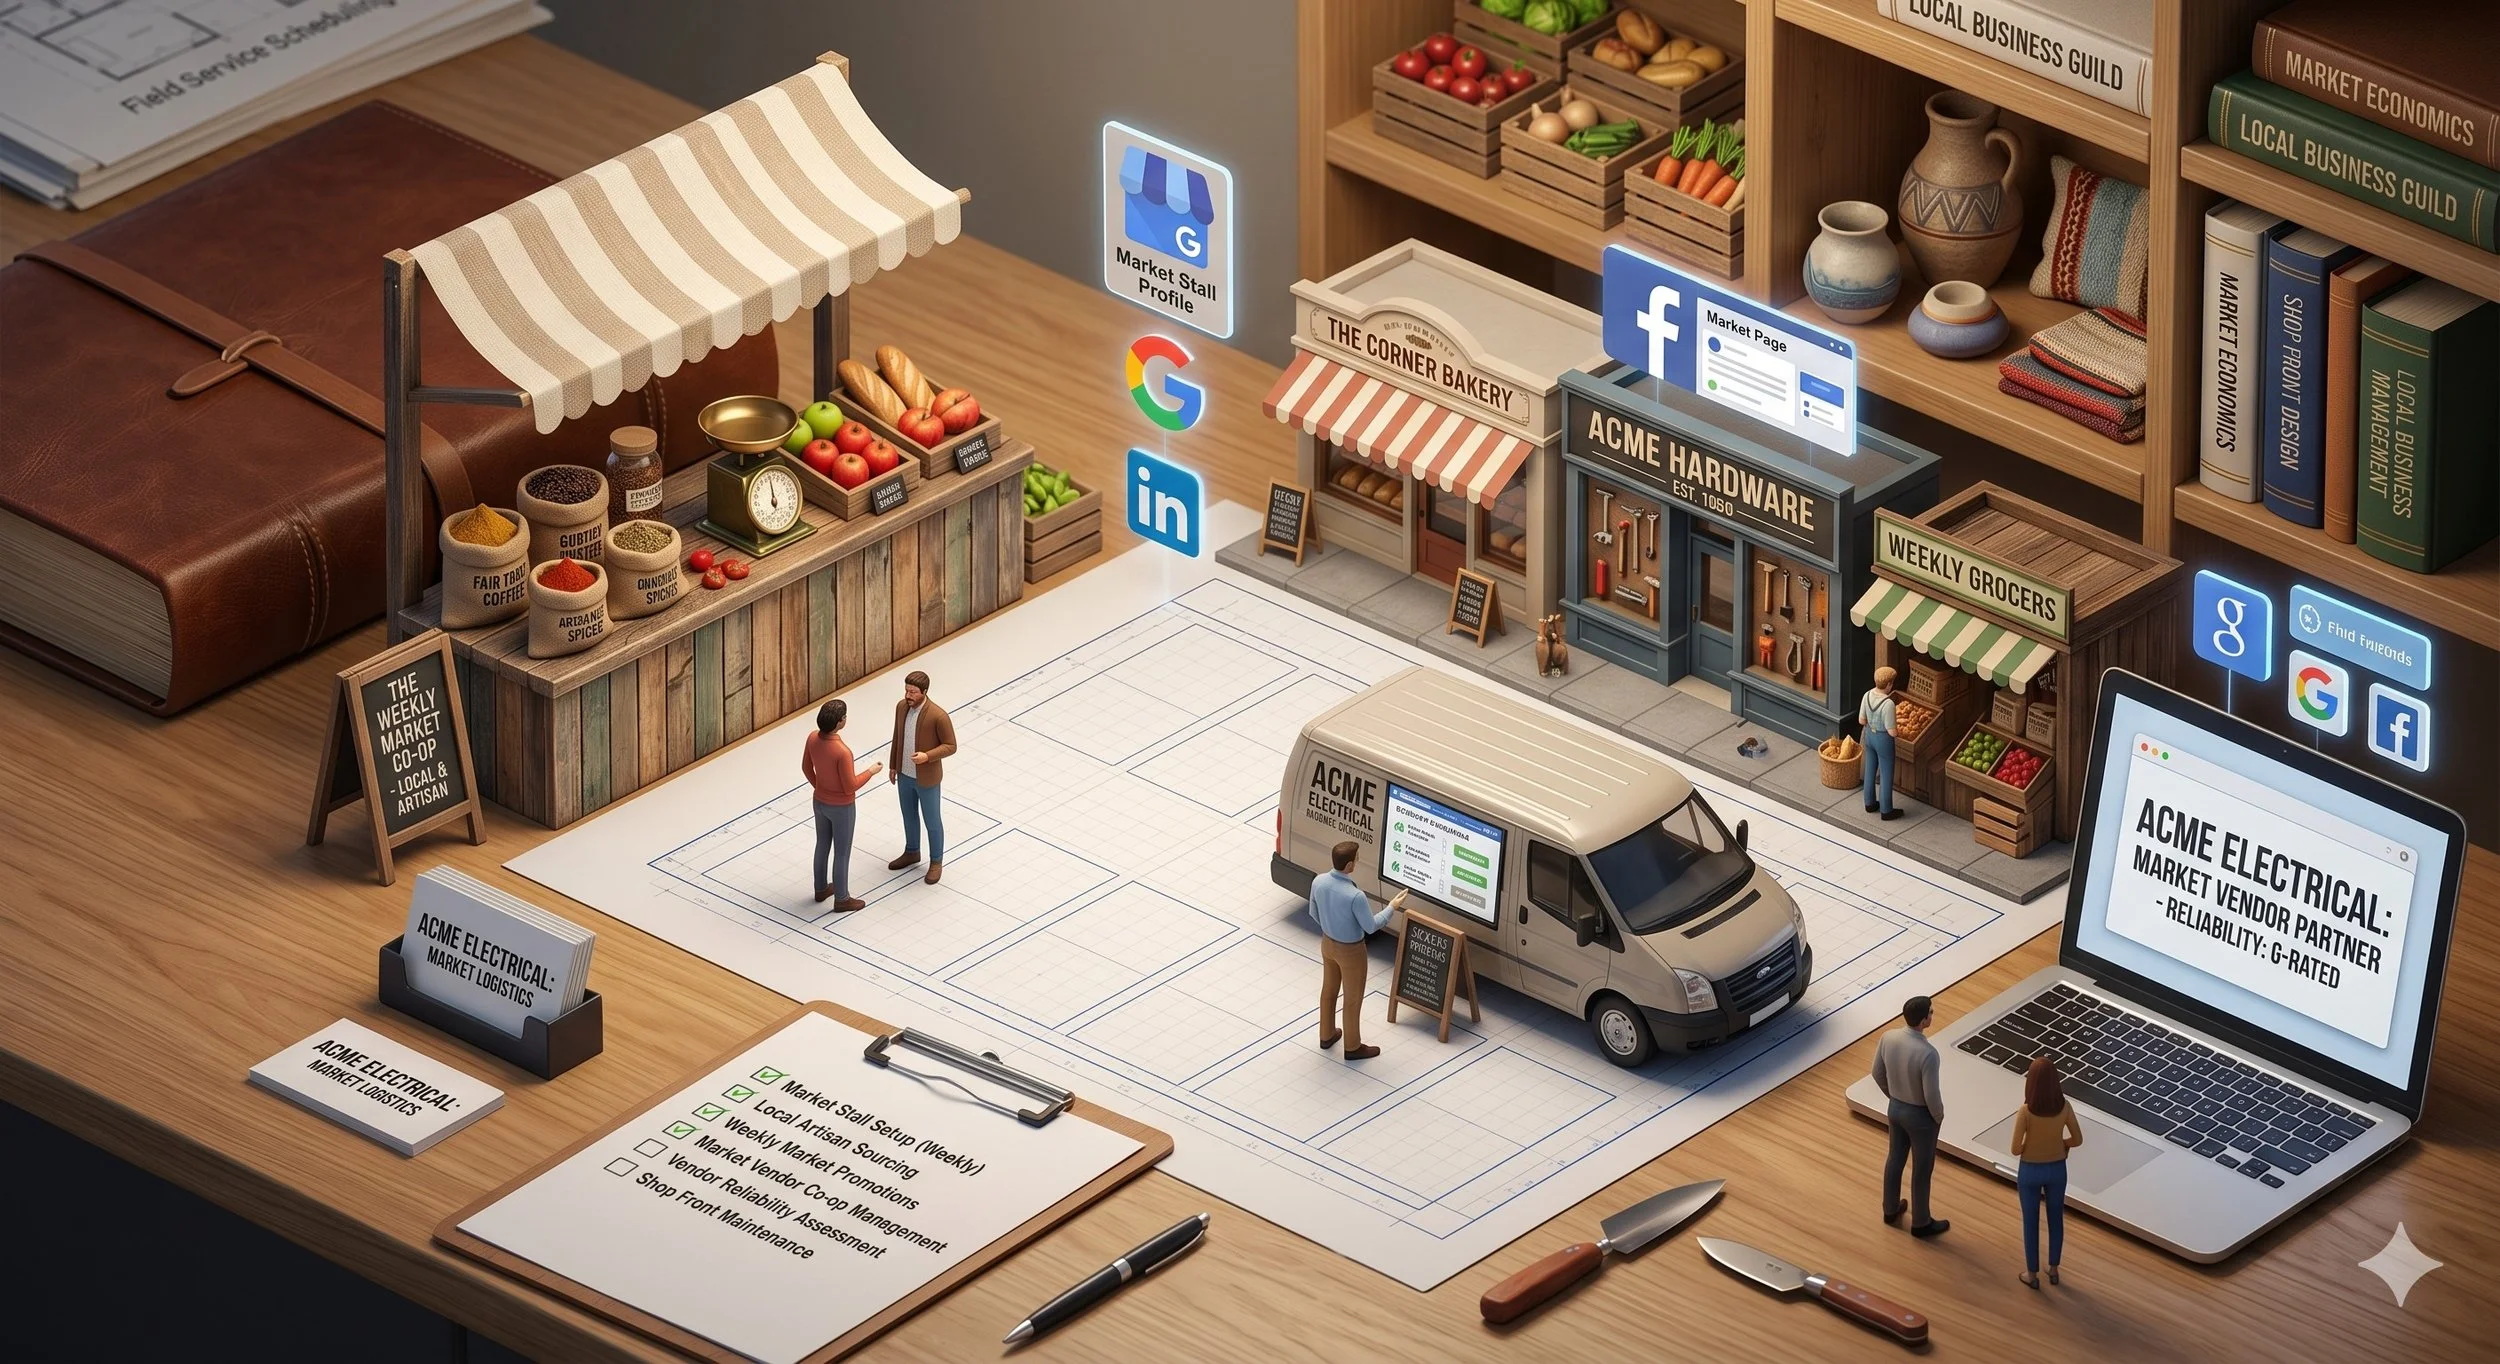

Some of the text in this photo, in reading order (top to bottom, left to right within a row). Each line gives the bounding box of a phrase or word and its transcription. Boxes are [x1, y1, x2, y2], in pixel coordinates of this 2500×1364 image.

[120, 79, 185, 115] Field
[180, 44, 270, 89] Service
[1972, 11, 2064, 68] BUSINESS
[2068, 48, 2124, 91] GUILD
[2285, 50, 2474, 147] MARKET ECONOMICS
[2240, 113, 2458, 222] LOCAL BUSINESS GUILD
[1116, 247, 1216, 301] Market Stall
[1175, 225, 1201, 258] G
[1139, 277, 1194, 313] Profile
[1636, 285, 1680, 380] f
[1706, 309, 1787, 353] Market Page
[2283, 294, 2303, 342] SHOP
[1126, 334, 1205, 431] G
[1327, 316, 1361, 351] THE
[1366, 333, 1437, 382] CORNER
[1442, 363, 1513, 412] BAKERY
[2215, 271, 2239, 452] MARKET ECONOMICS
[1588, 410, 1815, 532] ACME HARDWARE
[2280, 405, 2300, 471] DESIGN
[2369, 369, 2391, 499] MANAGEMENT
[2393, 369, 2416, 518] LOCAL BUSINESS
[1138, 466, 1188, 543] in
[1673, 479, 1697, 503] EST.
[473, 575, 500, 590] FAIR
[1888, 531, 2056, 622] WEEKLY GROCERS
[376, 687, 436, 731] WEEKLY
[387, 671, 419, 701] THE
[2296, 666, 2338, 721] G
[380, 710, 440, 755] MARKET
[392, 737, 437, 773] CO-OP
[2389, 712, 2412, 756] f
[398, 780, 449, 816] ARTISAN
[399, 766, 435, 796] LOCAL
[438, 761, 448, 778] &
[1311, 760, 1377, 813] ACME
[2136, 797, 2393, 938] ACME ELECTRICAL:
[2133, 844, 2382, 975] MARKET VENDOR PARTNER
[2166, 895, 2268, 960] RELIABILITY:
[2270, 942, 2341, 990] G-RATED
[417, 912, 555, 993] ACME ELECTRICAL:
[427, 945, 534, 1008] MARKET LOGISTICS
[307, 1059, 422, 1117] MARKET LOGISTICS
[312, 1039, 369, 1068] ACME
[724, 1116, 919, 1210] Weekly Market Promotions
[753, 1099, 920, 1180] Local Artisan Sourcing
[781, 1080, 986, 1177] Market Stall Setup (Weekly)
[667, 1153, 887, 1259] Vendor Reliability Assessment
[694, 1135, 752, 1166] Market
[750, 1159, 805, 1190] Vendor
[803, 1184, 849, 1211] Co-op
[636, 1172, 815, 1260] Shop Front Maintenance
